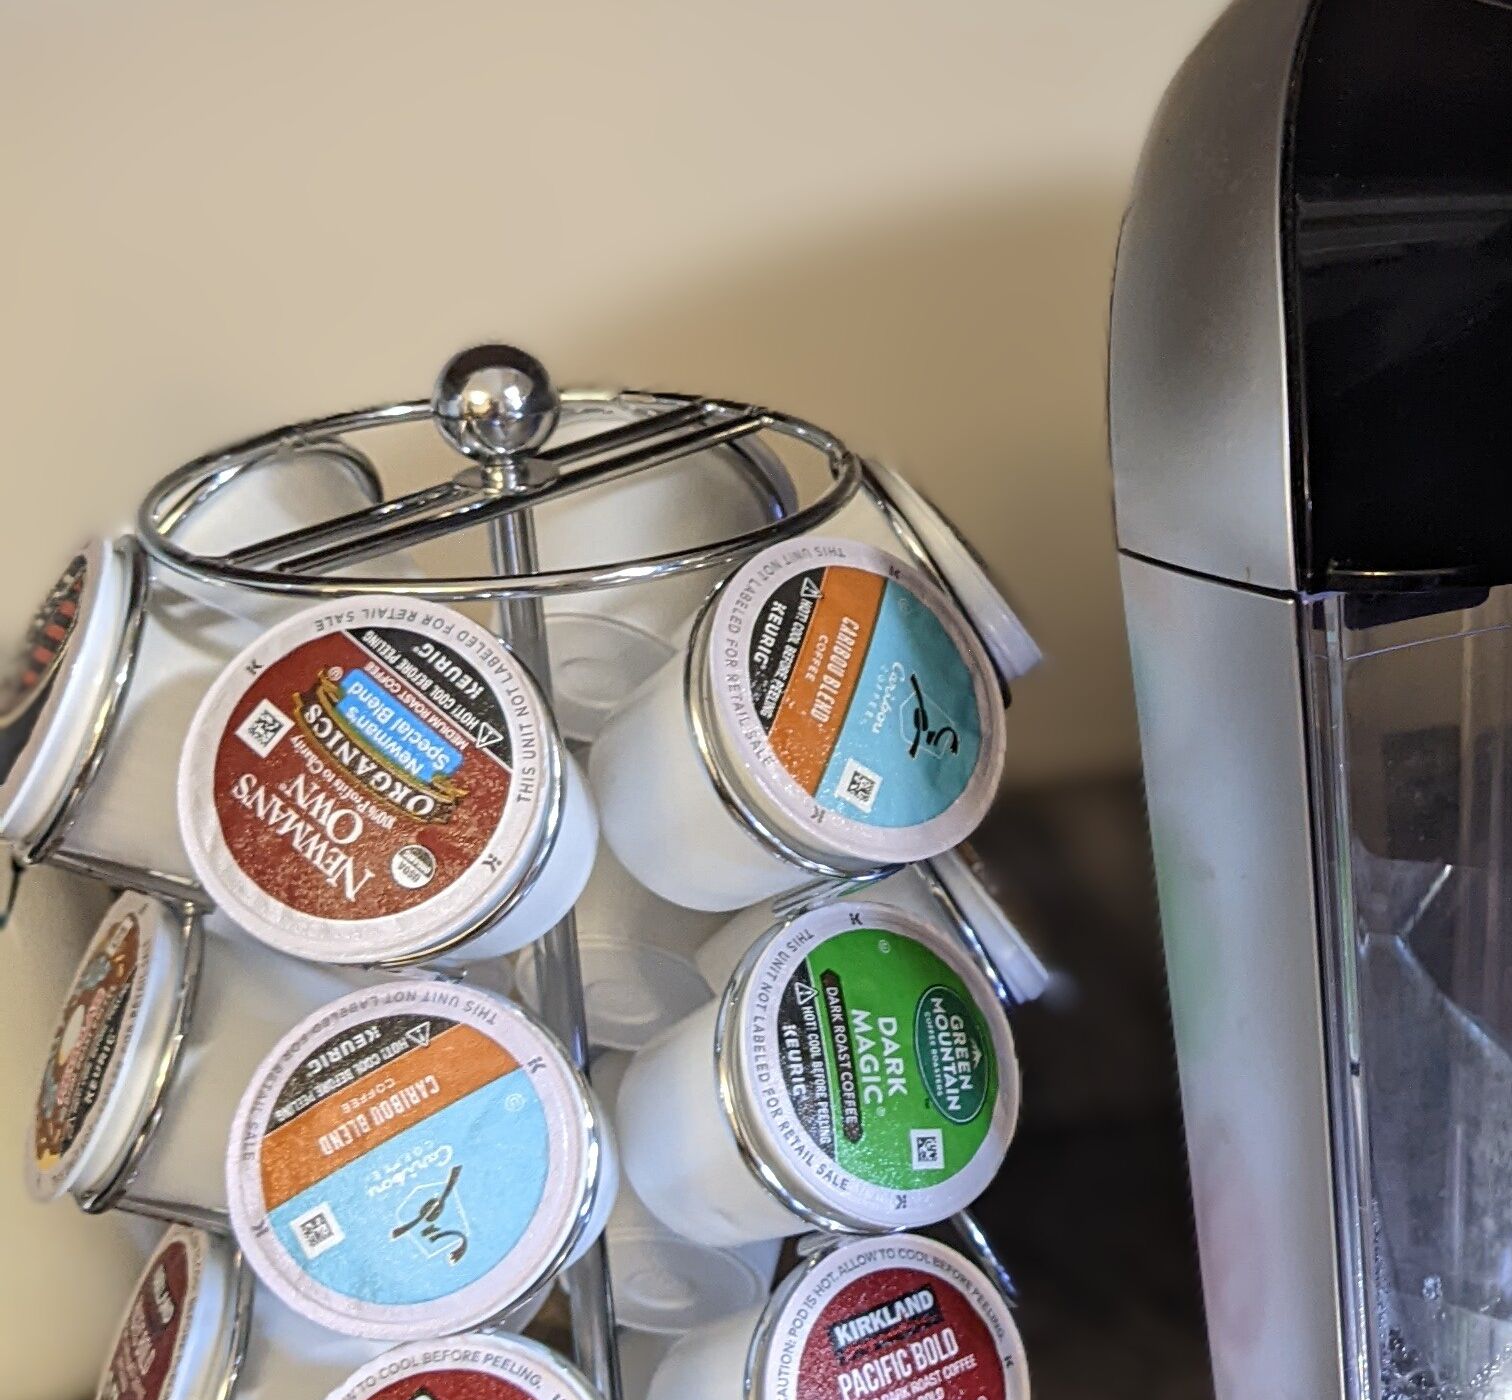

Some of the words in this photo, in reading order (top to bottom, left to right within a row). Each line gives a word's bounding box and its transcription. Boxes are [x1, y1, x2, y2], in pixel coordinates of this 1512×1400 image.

[814, 547, 846, 558] THIS
[312, 610, 356, 632] SALE
[361, 608, 417, 622] RETAIL
[421, 613, 455, 636] FOR
[728, 577, 763, 633] LABELED
[362, 629, 402, 664] PEELING
[725, 638, 738, 667] FOR
[753, 600, 787, 666] KEURIG
[826, 616, 860, 679] CARIBOU
[364, 660, 403, 694] COFFEE
[397, 658, 435, 692] BEFORE
[420, 643, 485, 700] KEURIG
[456, 629, 513, 685] LABELED
[805, 634, 829, 682] COFFEE
[348, 682, 395, 724] Blend
[400, 690, 432, 718] ROAST
[505, 689, 529, 717] NOT
[726, 674, 750, 727] RETAIL
[810, 674, 841, 723] BLEND
[345, 707, 424, 775] Newman's
[392, 717, 449, 770] Special
[427, 712, 469, 750] MEDIUM
[520, 723, 536, 761] UNIT
[303, 704, 435, 816] ORGANICS
[517, 766, 536, 802] THIS
[285, 773, 363, 844] OWN
[231, 773, 376, 901] NEWMAN'S
[786, 928, 816, 952] THIS
[767, 951, 791, 981] UNIT
[388, 991, 417, 1004] NOT
[422, 991, 460, 1008] UNIT
[463, 1000, 498, 1025] THIS
[756, 982, 774, 1012] NOT
[801, 1006, 818, 1031] HOT!
[826, 986, 844, 1022] DARK
[306, 1025, 382, 1076] KEURIG
[752, 1015, 771, 1083] LABELED
[781, 1024, 808, 1098] KEURIG
[808, 1033, 822, 1059] COOL
[833, 1025, 852, 1069] ROAST
[851, 1009, 884, 1105] MAGIC
[878, 1017, 908, 1097] DARK
[930, 998, 962, 1111] MOUNTAIN
[950, 1014, 974, 1090] GREEN
[339, 1078, 397, 1114] COFFEE
[372, 1074, 441, 1126] CARIBOU
[811, 1061, 828, 1099] BEFORE
[841, 1071, 858, 1124] COFFEE
[762, 1088, 784, 1119] FOR
[817, 1101, 832, 1145] PEELING
[318, 1112, 371, 1156] BLEND
[778, 1121, 816, 1167] RETAIL
[816, 1163, 850, 1191] SALE
[789, 1308, 809, 1337] POD
[806, 1295, 817, 1310] IS
[812, 1271, 839, 1297] HOT.
[837, 1251, 877, 1276] ALLOW
[880, 1248, 896, 1260] TO
[833, 1289, 934, 1349] KIRKLAND
[378, 1355, 419, 1379] COOL
[422, 1350, 480, 1363] BEFORE
[909, 1327, 959, 1372] BOLD
